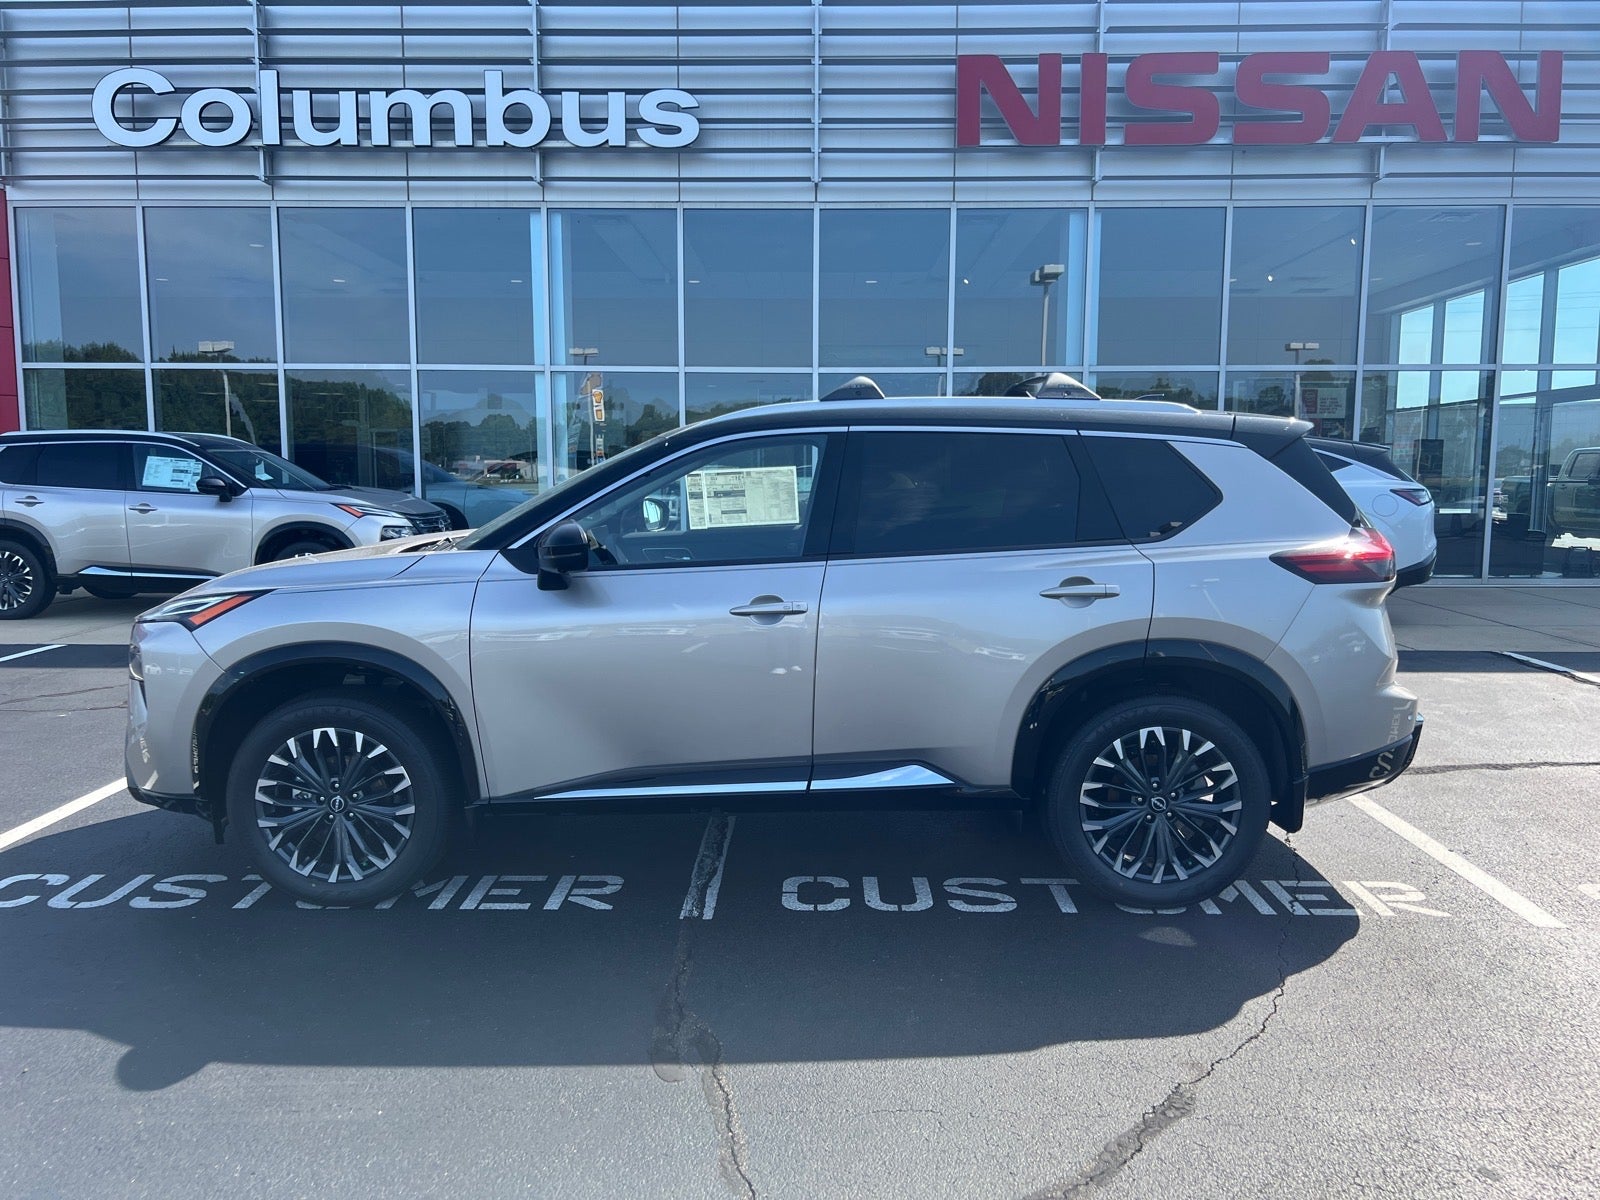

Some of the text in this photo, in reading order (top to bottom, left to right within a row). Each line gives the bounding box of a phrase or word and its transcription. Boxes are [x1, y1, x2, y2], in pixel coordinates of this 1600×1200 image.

[91, 67, 701, 148] Columbus
[956, 50, 1563, 147] NISSAN
[0, 874, 624, 910] CUSTMER
[781, 876, 1451, 917] CUSTMER
